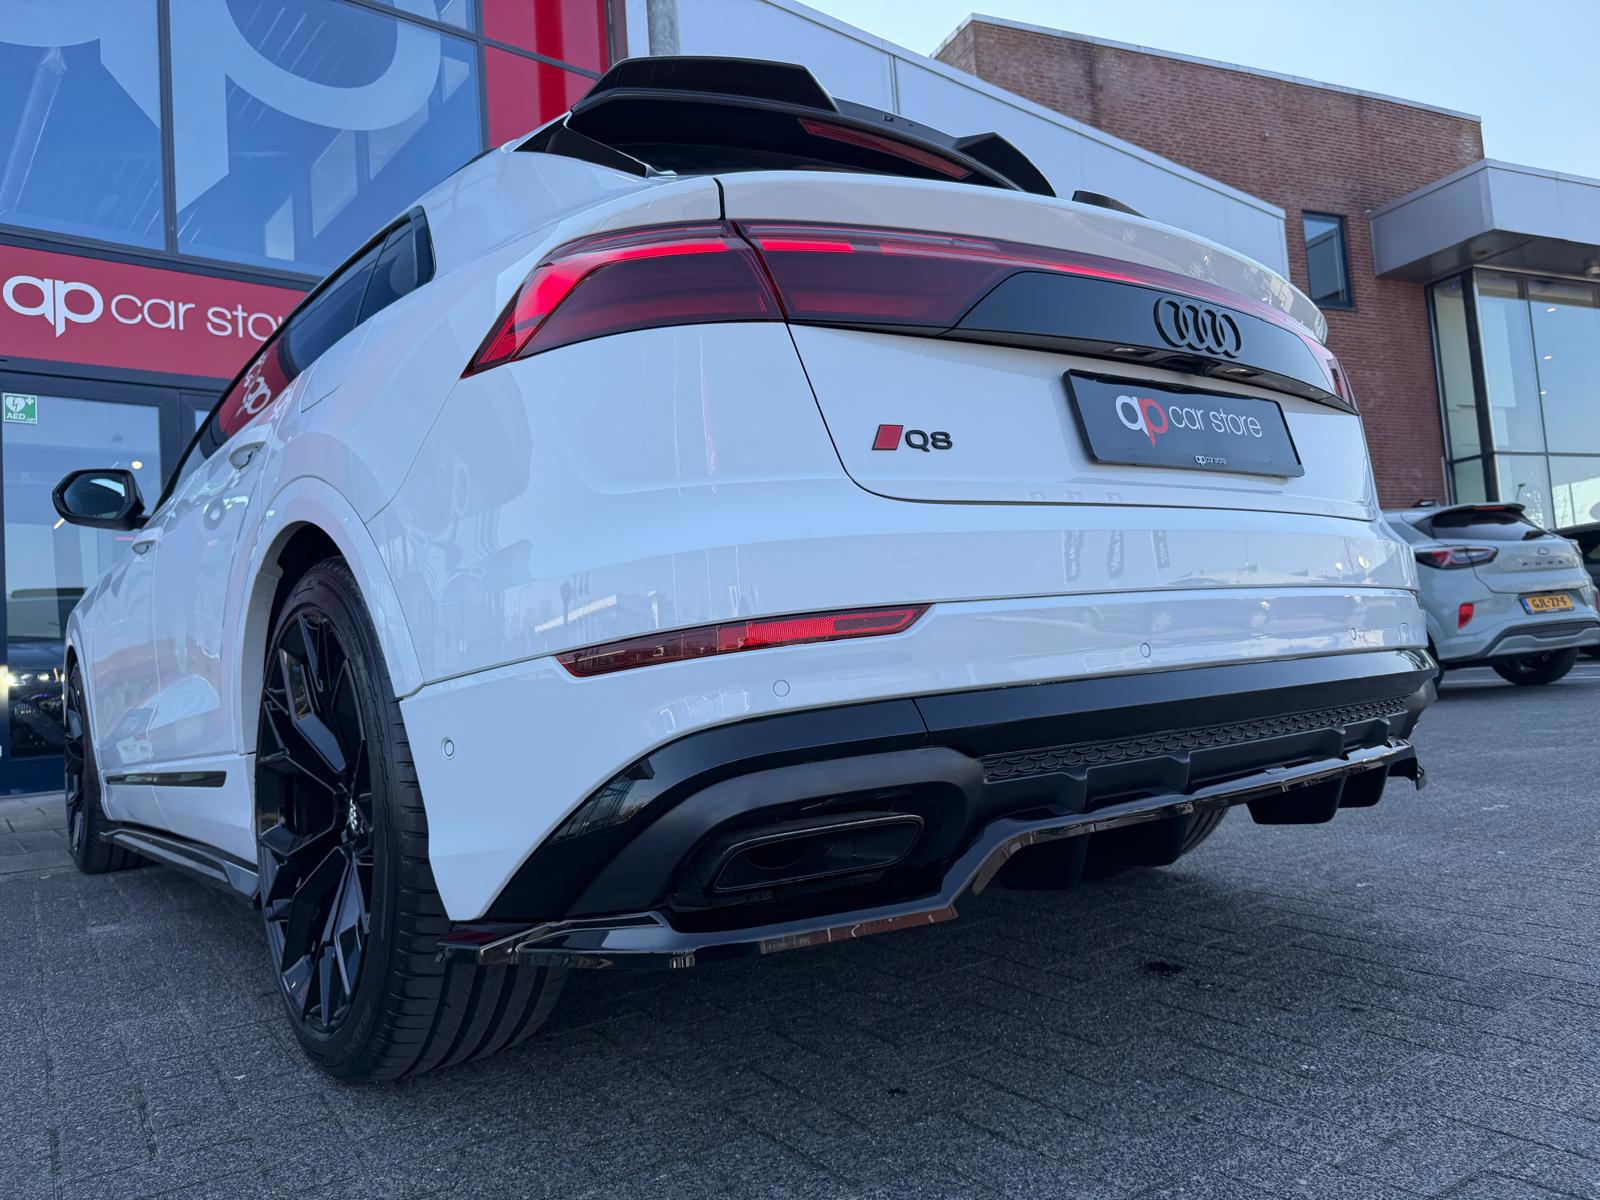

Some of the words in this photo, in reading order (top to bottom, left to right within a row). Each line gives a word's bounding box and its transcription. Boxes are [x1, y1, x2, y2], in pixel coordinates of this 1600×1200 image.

[3, 275, 104, 338] ap
[111, 294, 195, 331] car
[206, 303, 284, 342] sto
[6, 412, 26, 420] AED
[1115, 395, 1169, 448] ap
[1169, 405, 1204, 431] car
[1209, 408, 1263, 438] store
[905, 429, 953, 452] Q8
